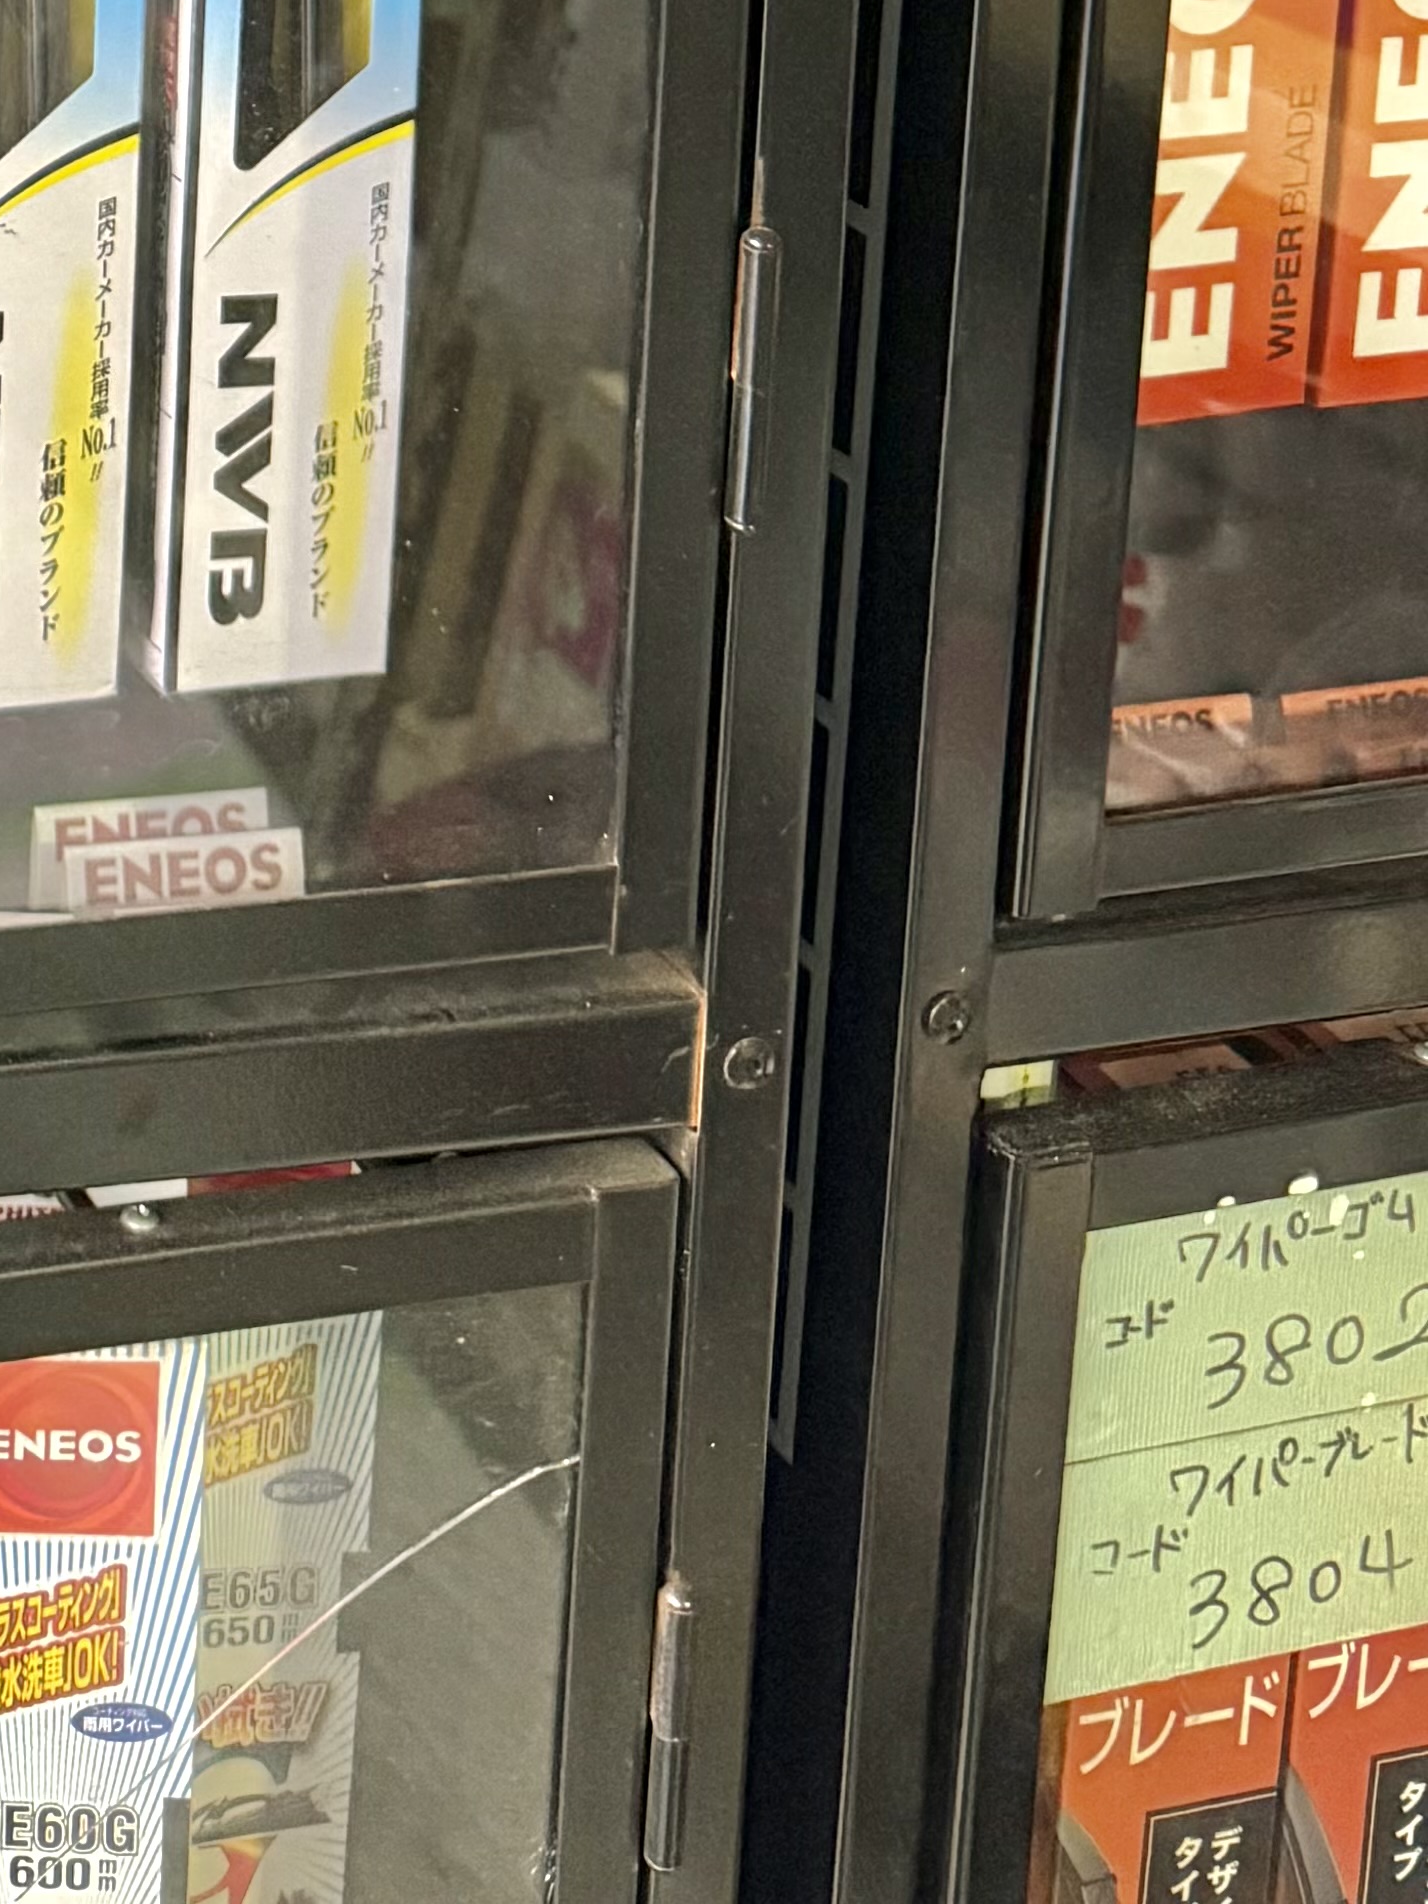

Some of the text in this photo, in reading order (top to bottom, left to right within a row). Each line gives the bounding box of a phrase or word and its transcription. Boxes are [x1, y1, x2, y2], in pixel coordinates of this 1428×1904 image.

[1267, 84, 1317, 361] WIPER BLADE
[207, 295, 278, 628] NWB
[85, 843, 284, 907] ENEOS
[1106, 1282, 1428, 1409] コード 3802
[202, 1567, 317, 1612] E65G
[1092, 1525, 1415, 1650] コード 3804
[83, 1715, 164, 1734] 雨用ワイパー
[1079, 1670, 1280, 1775] ブレード
[1, 1802, 139, 1856] E60G
[1394, 1781, 1427, 1882] タイプ
